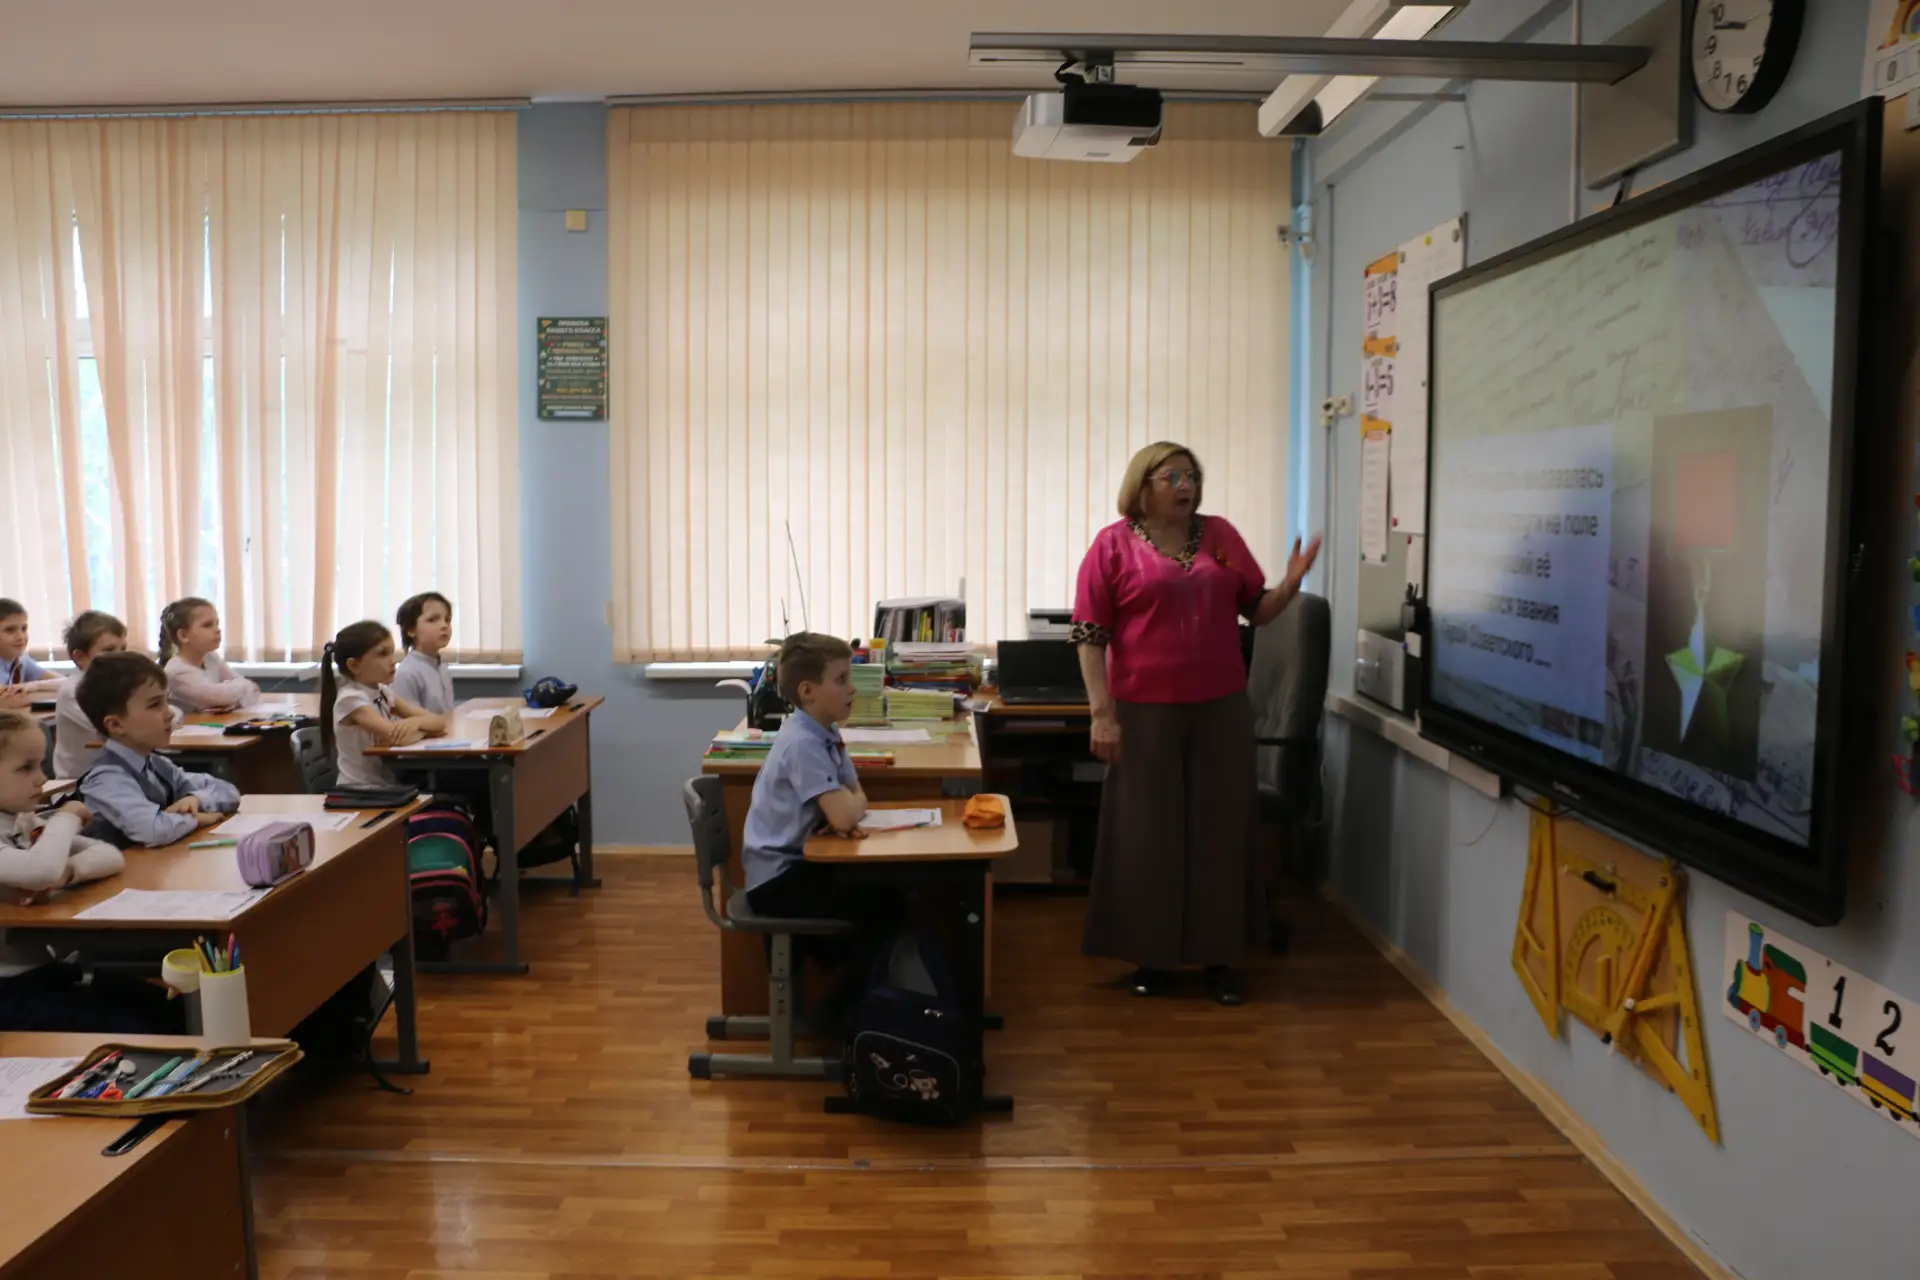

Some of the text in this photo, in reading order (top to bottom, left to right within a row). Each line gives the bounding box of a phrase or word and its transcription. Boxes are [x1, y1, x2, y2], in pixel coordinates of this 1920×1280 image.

[1710, 4, 1725, 23] 10
[1706, 35, 1717, 55] 9
[1711, 60, 1722, 80] 8
[1886, 60, 1897, 82] 0
[1723, 72, 1733, 94] 7
[1736, 74, 1748, 95] 6
[1564, 514, 1598, 537] поле
[1515, 597, 1560, 625] звания
[1828, 976, 1902, 1056] 1 2
